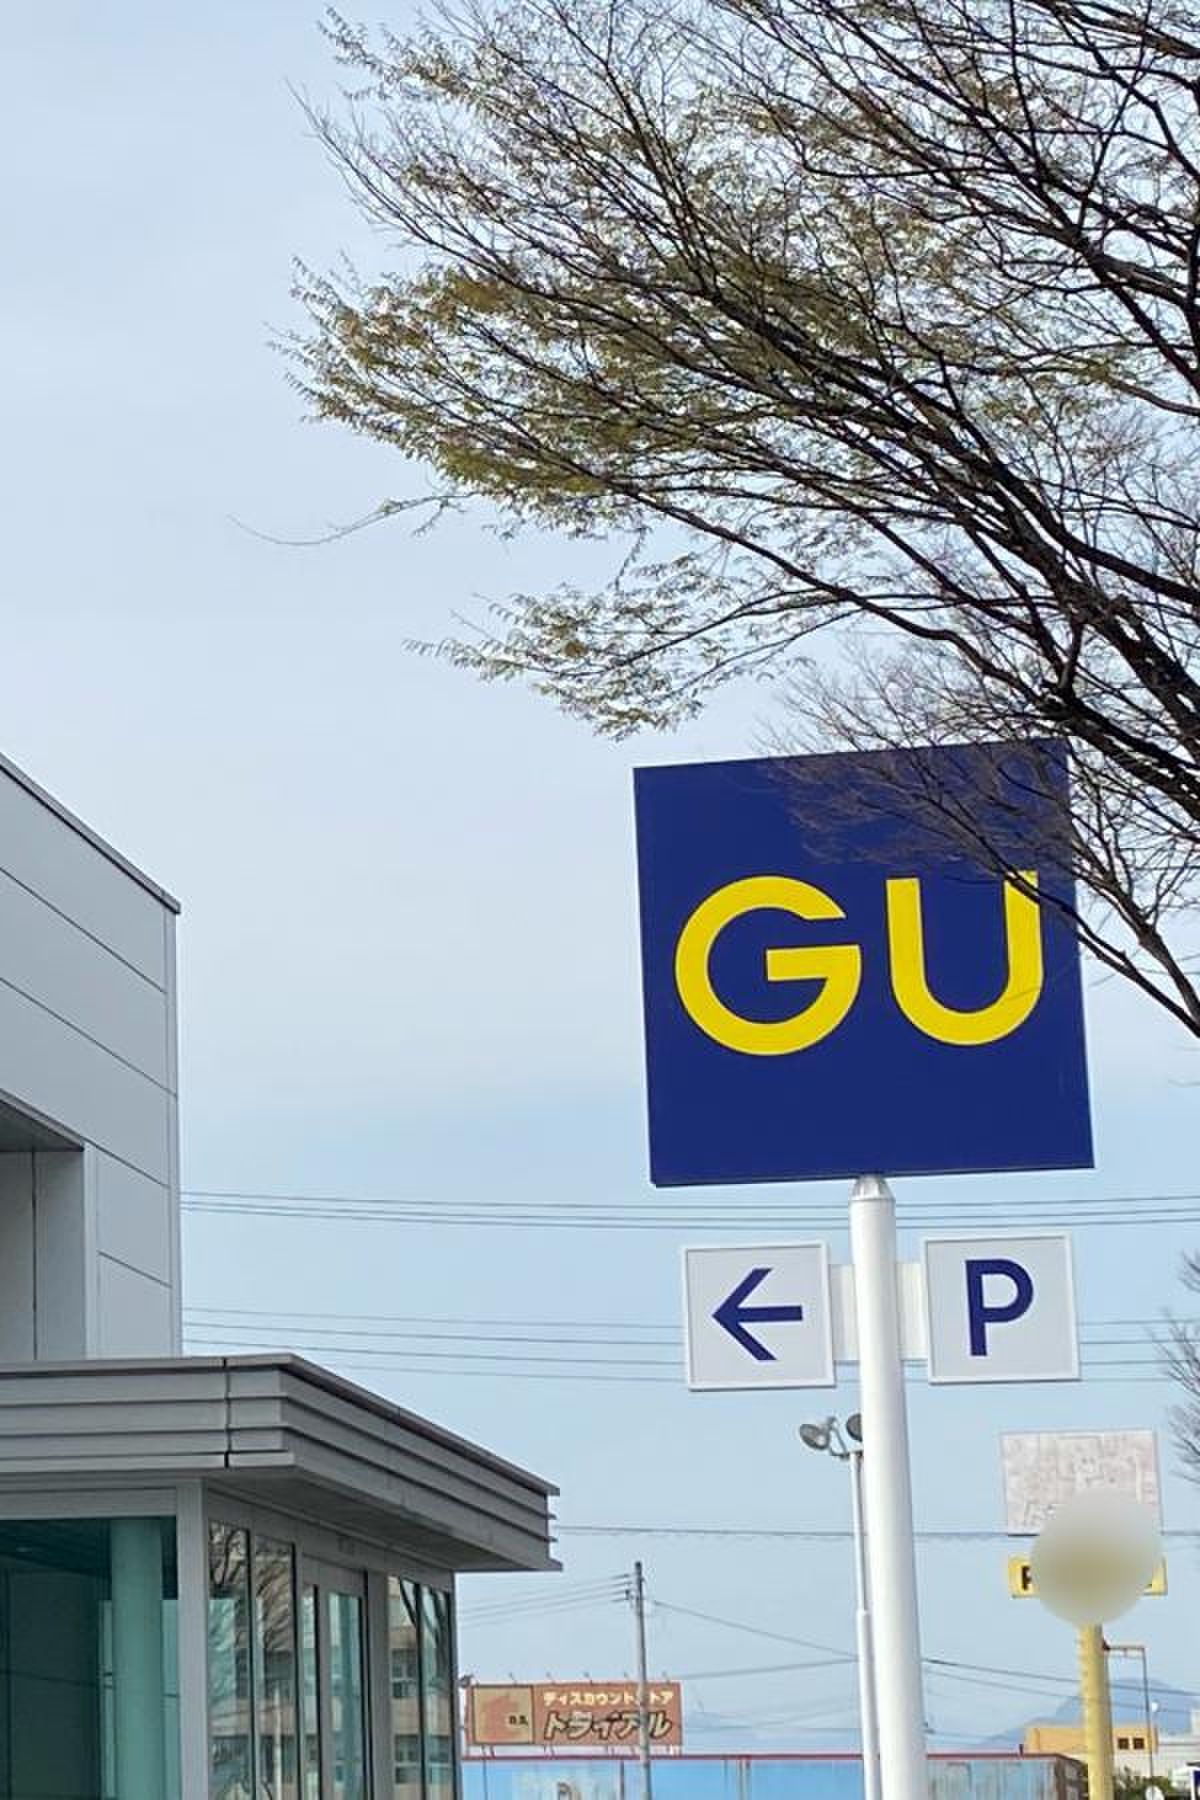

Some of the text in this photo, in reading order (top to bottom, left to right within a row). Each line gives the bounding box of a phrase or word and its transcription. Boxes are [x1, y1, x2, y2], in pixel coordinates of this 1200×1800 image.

[674, 871, 1043, 1056] GU
[965, 1259, 1034, 1357] P
[543, 1690, 673, 1707] ディスカウントトア
[543, 1709, 673, 1740] トライアル
